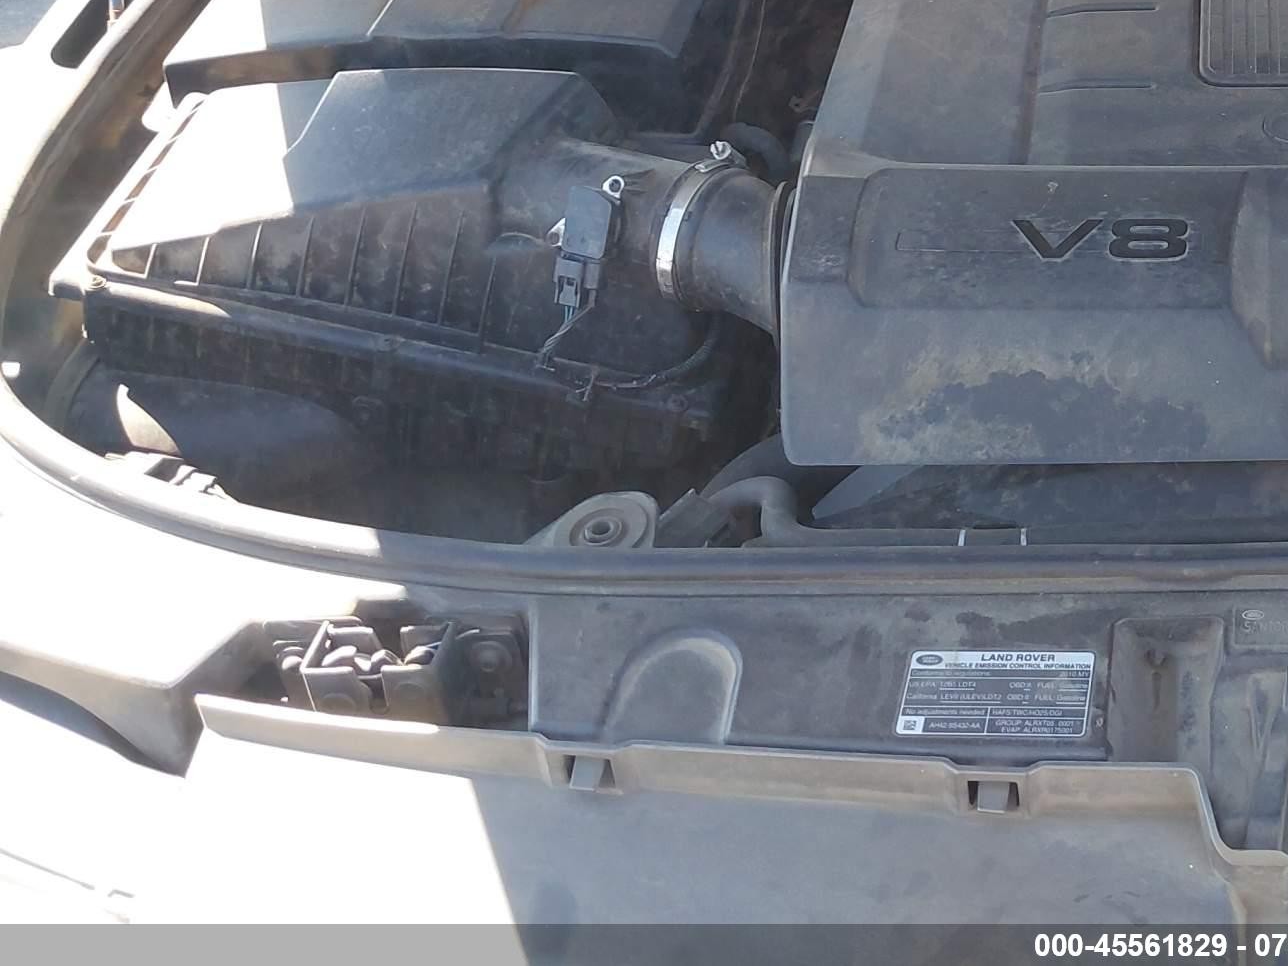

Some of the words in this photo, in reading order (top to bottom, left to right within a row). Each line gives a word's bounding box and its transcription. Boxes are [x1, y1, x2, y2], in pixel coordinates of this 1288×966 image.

[1010, 218, 1189, 262] V8
[981, 653, 1014, 662] LAND
[1016, 653, 1056, 662] ROVER
